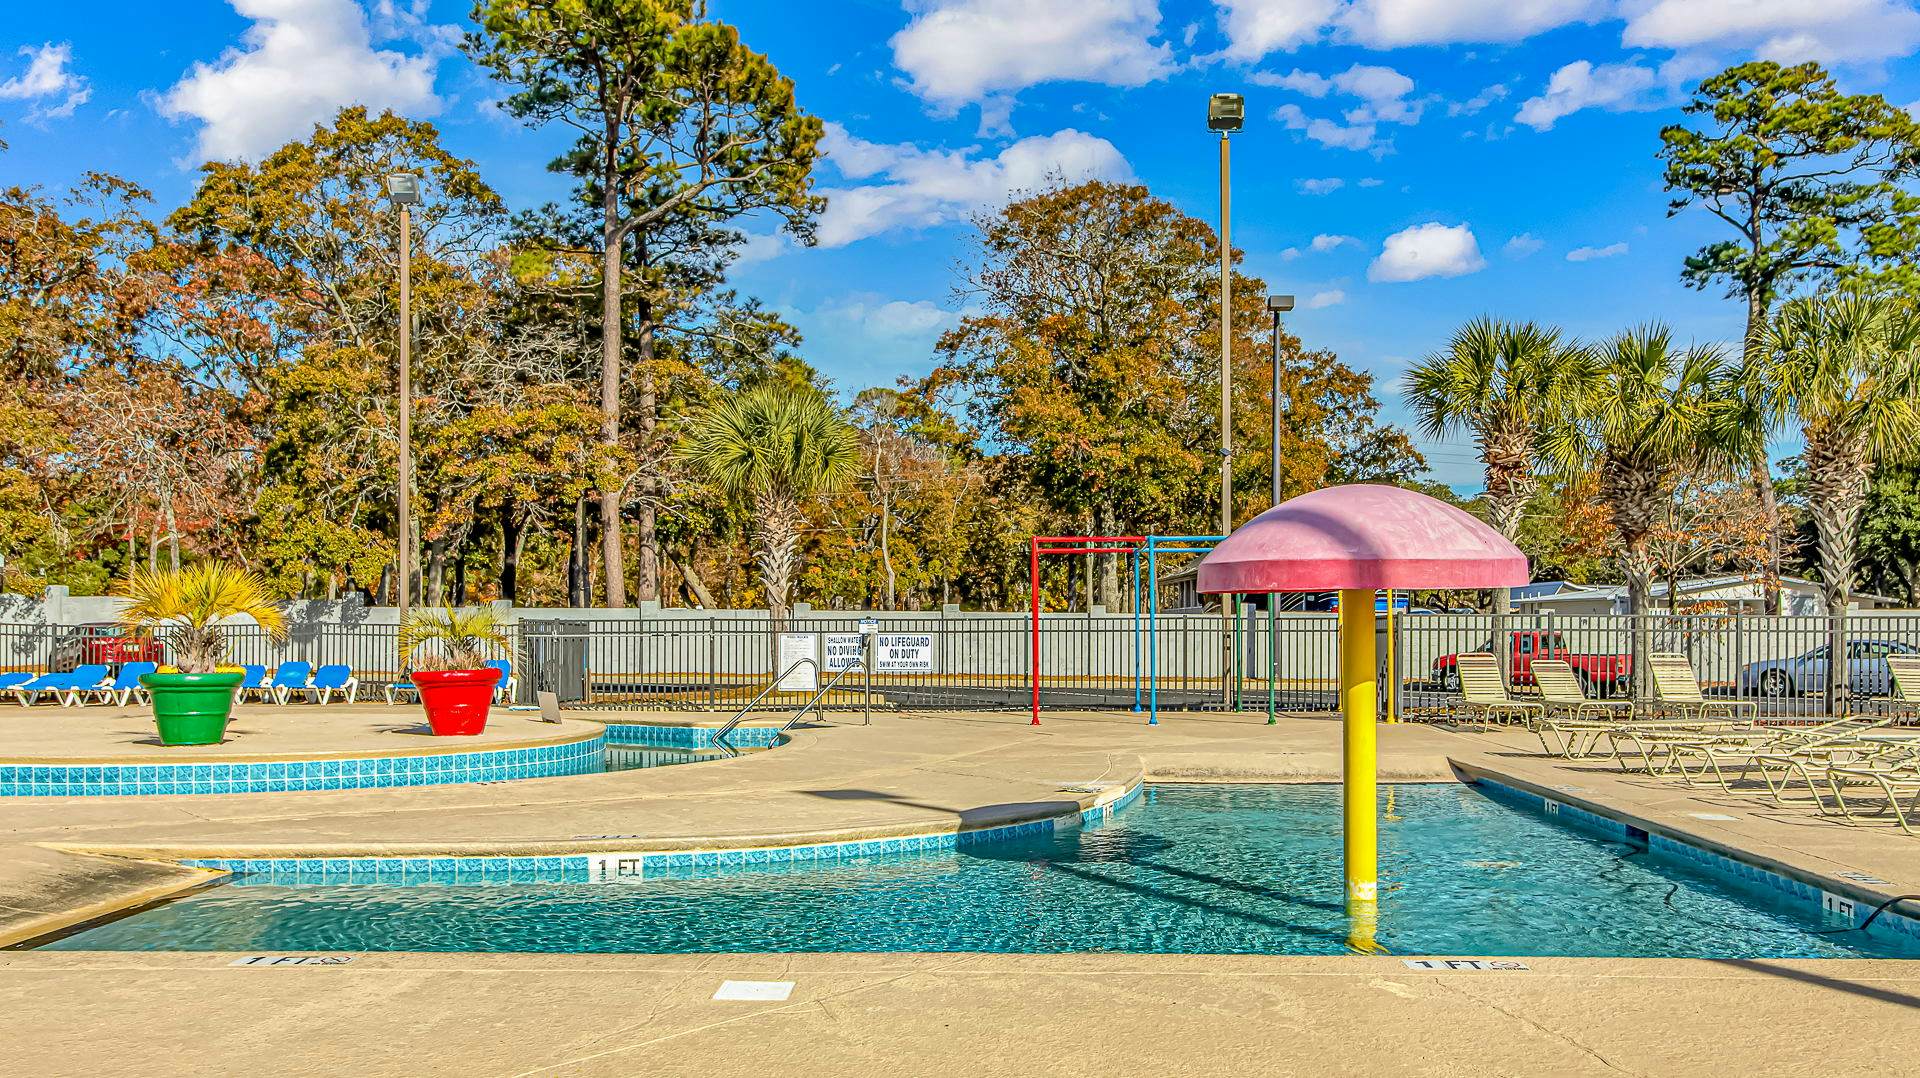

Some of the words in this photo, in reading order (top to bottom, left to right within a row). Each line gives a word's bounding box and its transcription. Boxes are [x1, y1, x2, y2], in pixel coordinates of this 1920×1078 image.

[879, 637, 889, 647] NO
[891, 637, 930, 647] LIFEGUARD
[828, 646, 837, 656] NO
[839, 646, 862, 656] DIVING
[889, 649, 899, 659] ON
[901, 649, 919, 659] DUTY
[599, 860, 606, 875] 1
[1827, 897, 1833, 910] 1
[1840, 901, 1853, 917] FT
[1415, 961, 1434, 969] 1
[1443, 960, 1482, 970] FT
